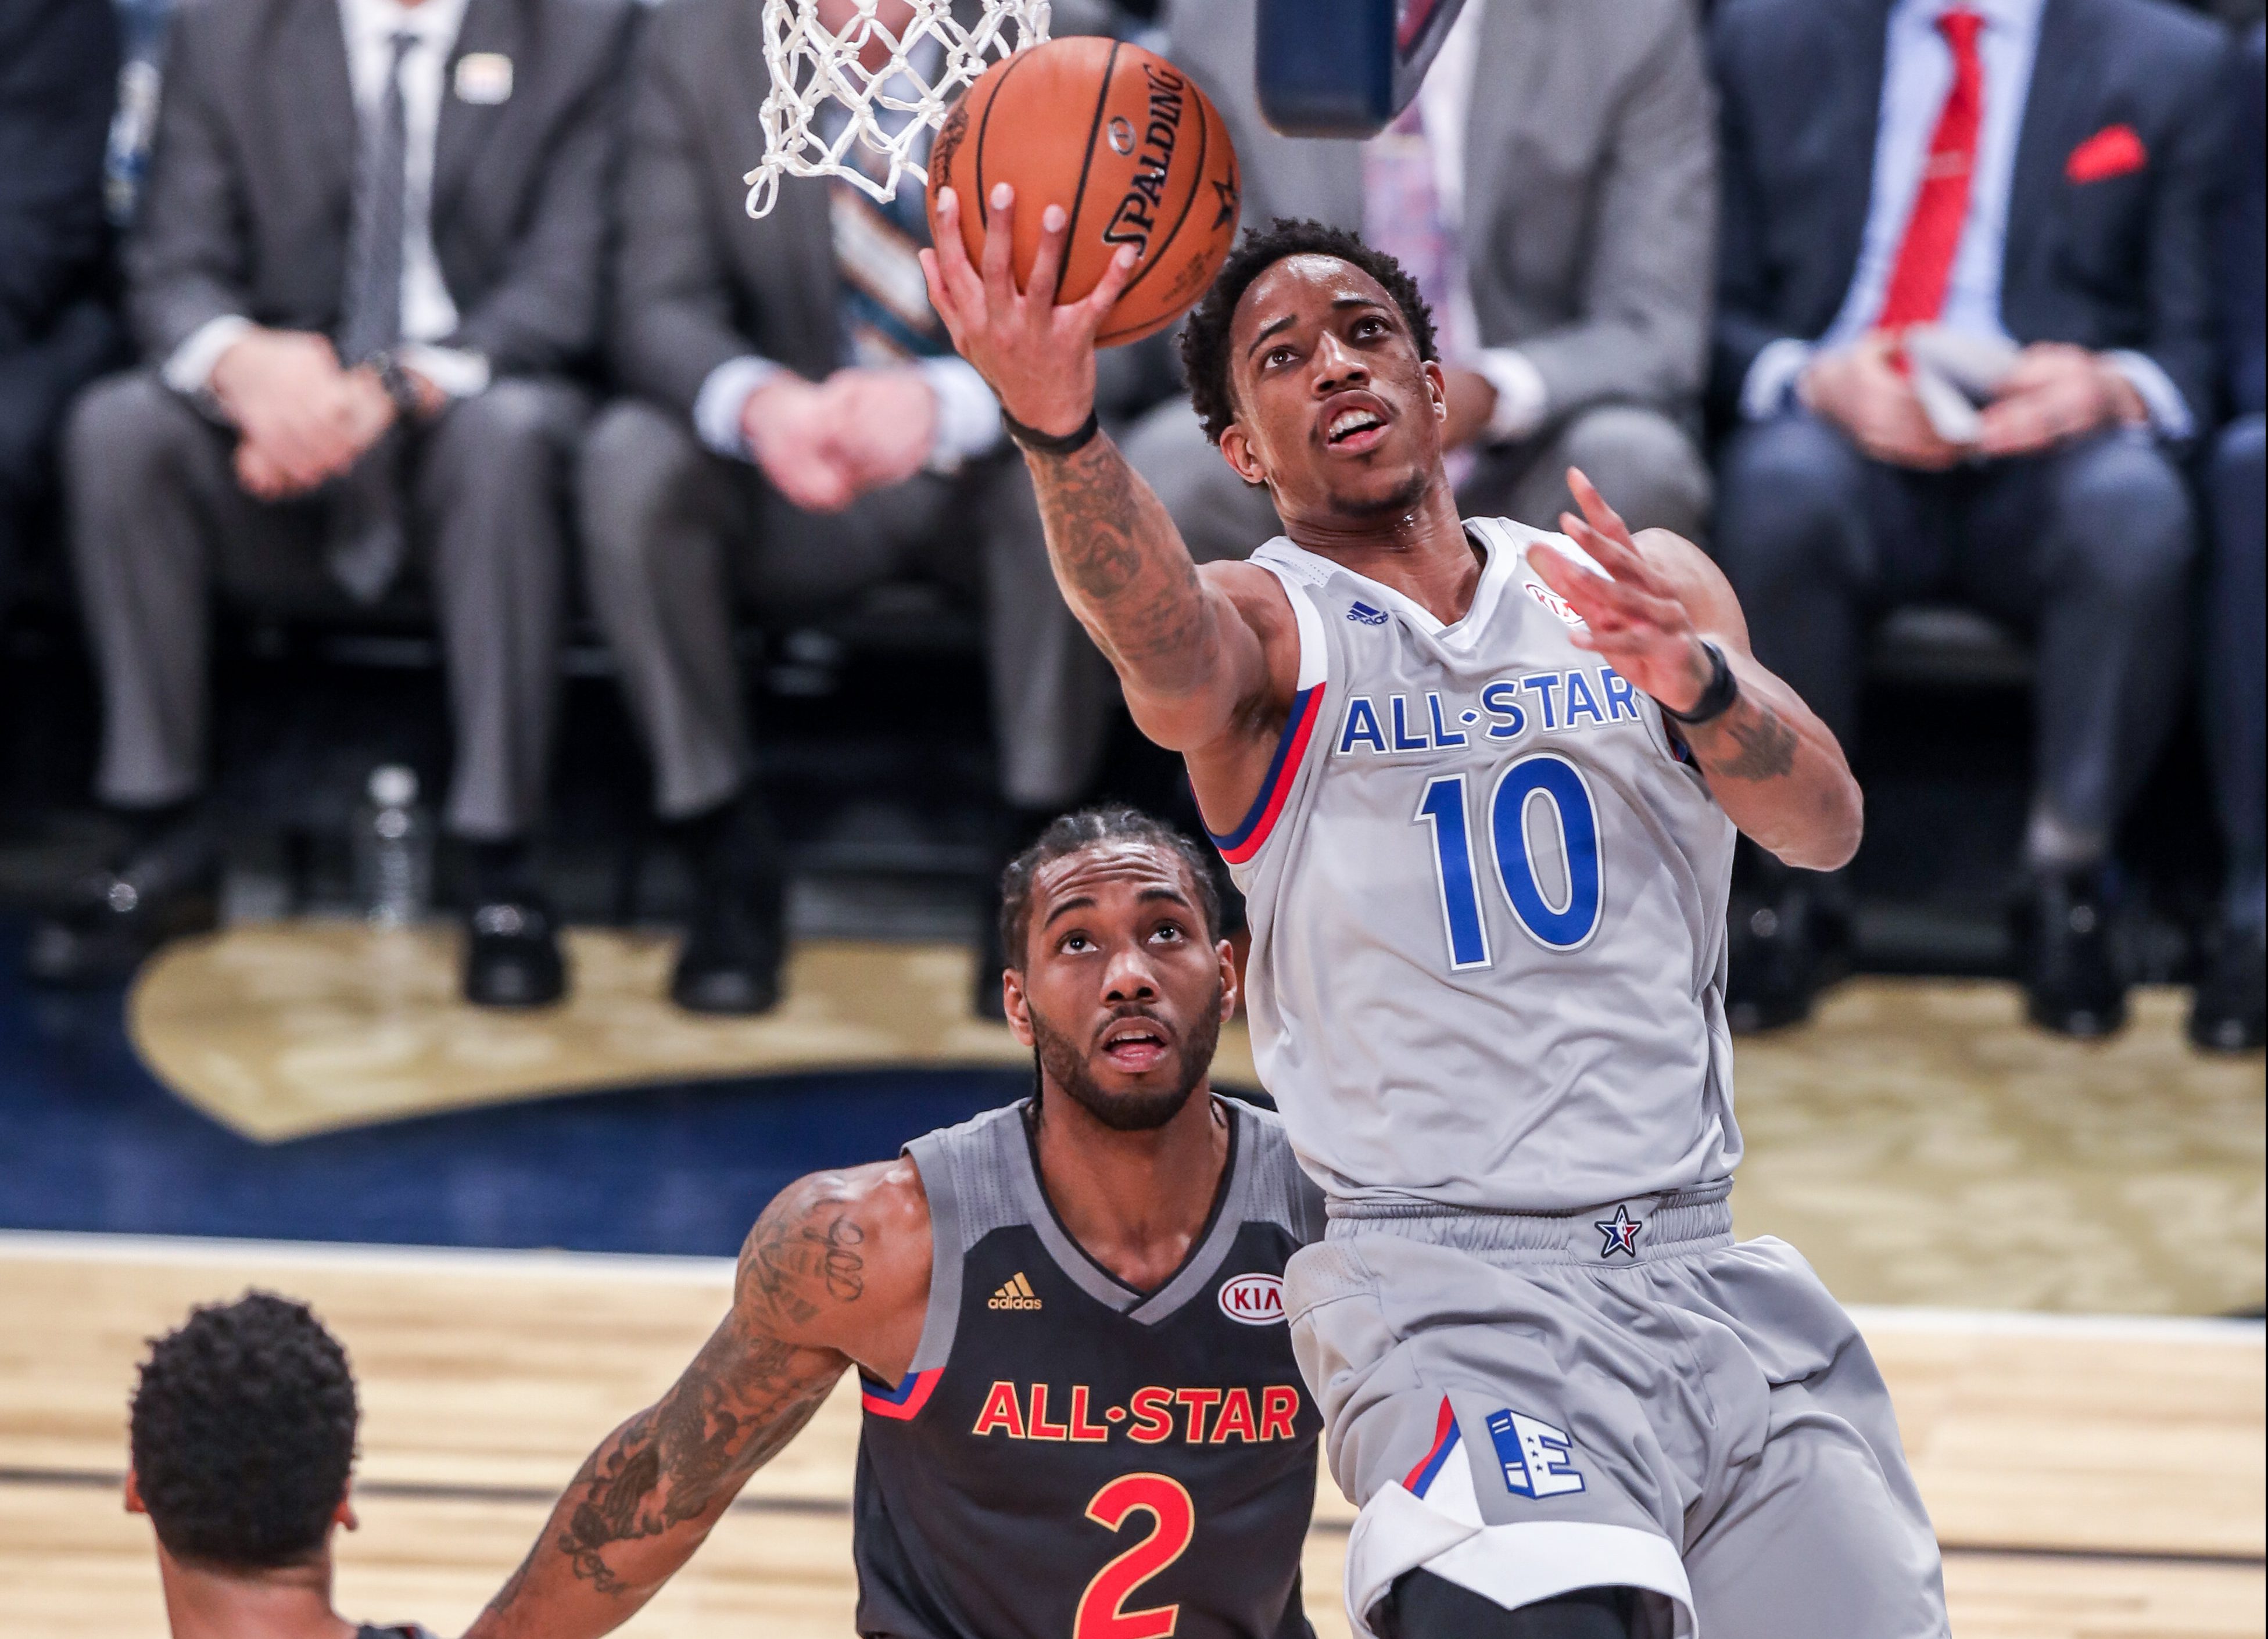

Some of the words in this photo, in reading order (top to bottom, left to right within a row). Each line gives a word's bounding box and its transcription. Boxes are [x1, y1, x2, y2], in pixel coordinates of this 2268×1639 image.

[1102, 63, 1184, 259] SPALDING
[1414, 751, 1605, 972] 10
[987, 1296, 1042, 1310] adidas
[1234, 1287, 1282, 1310] KIA
[1486, 1408, 1586, 1501] E
[1072, 1471, 1195, 1639] 2
